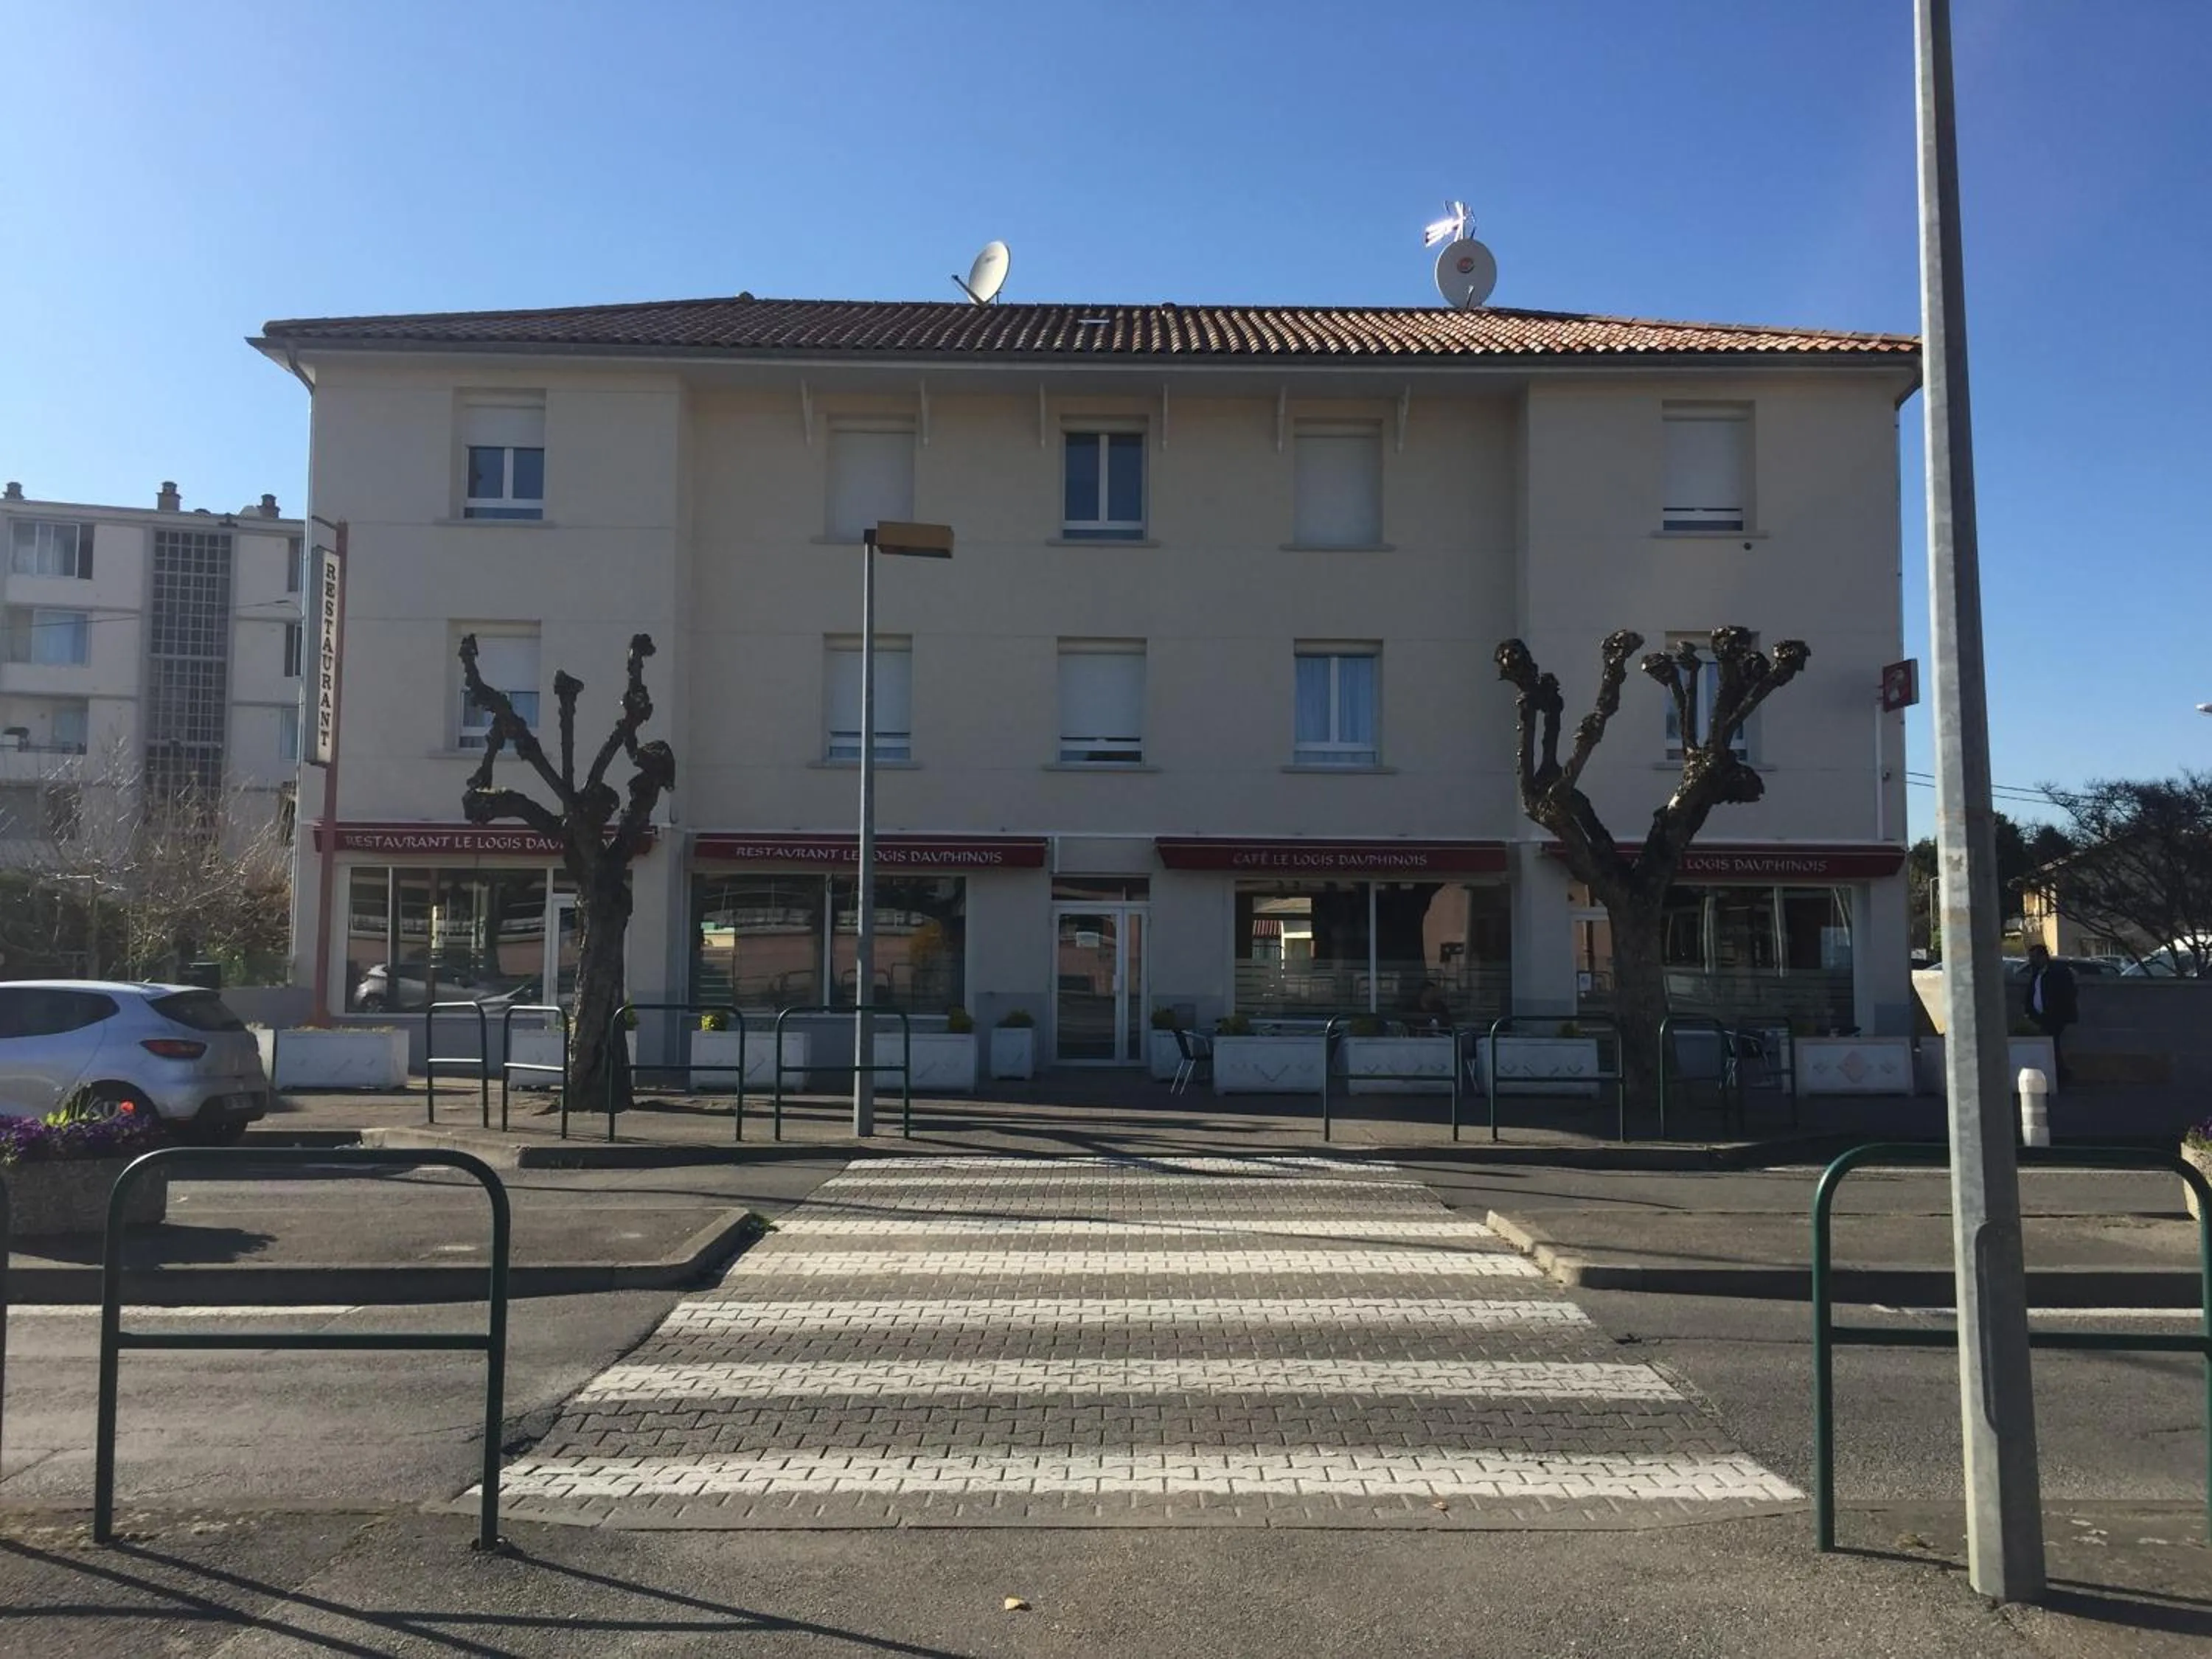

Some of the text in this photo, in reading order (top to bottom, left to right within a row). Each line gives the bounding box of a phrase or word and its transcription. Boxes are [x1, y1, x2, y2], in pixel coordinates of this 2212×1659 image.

[320, 563, 336, 746] RESTAURANT
[345, 835, 451, 848] RESTAURANT
[455, 836, 473, 848] LE
[477, 836, 521, 849] LOGIS
[736, 846, 1004, 863] RESTAURANT LE OGIS DAUPHINOIS
[1233, 850, 1427, 866] CAFÉ LE LOGIS DAUPHINOIS
[1686, 858, 1731, 871] LOGIS
[1734, 858, 1829, 872] DAUPHINOIS
